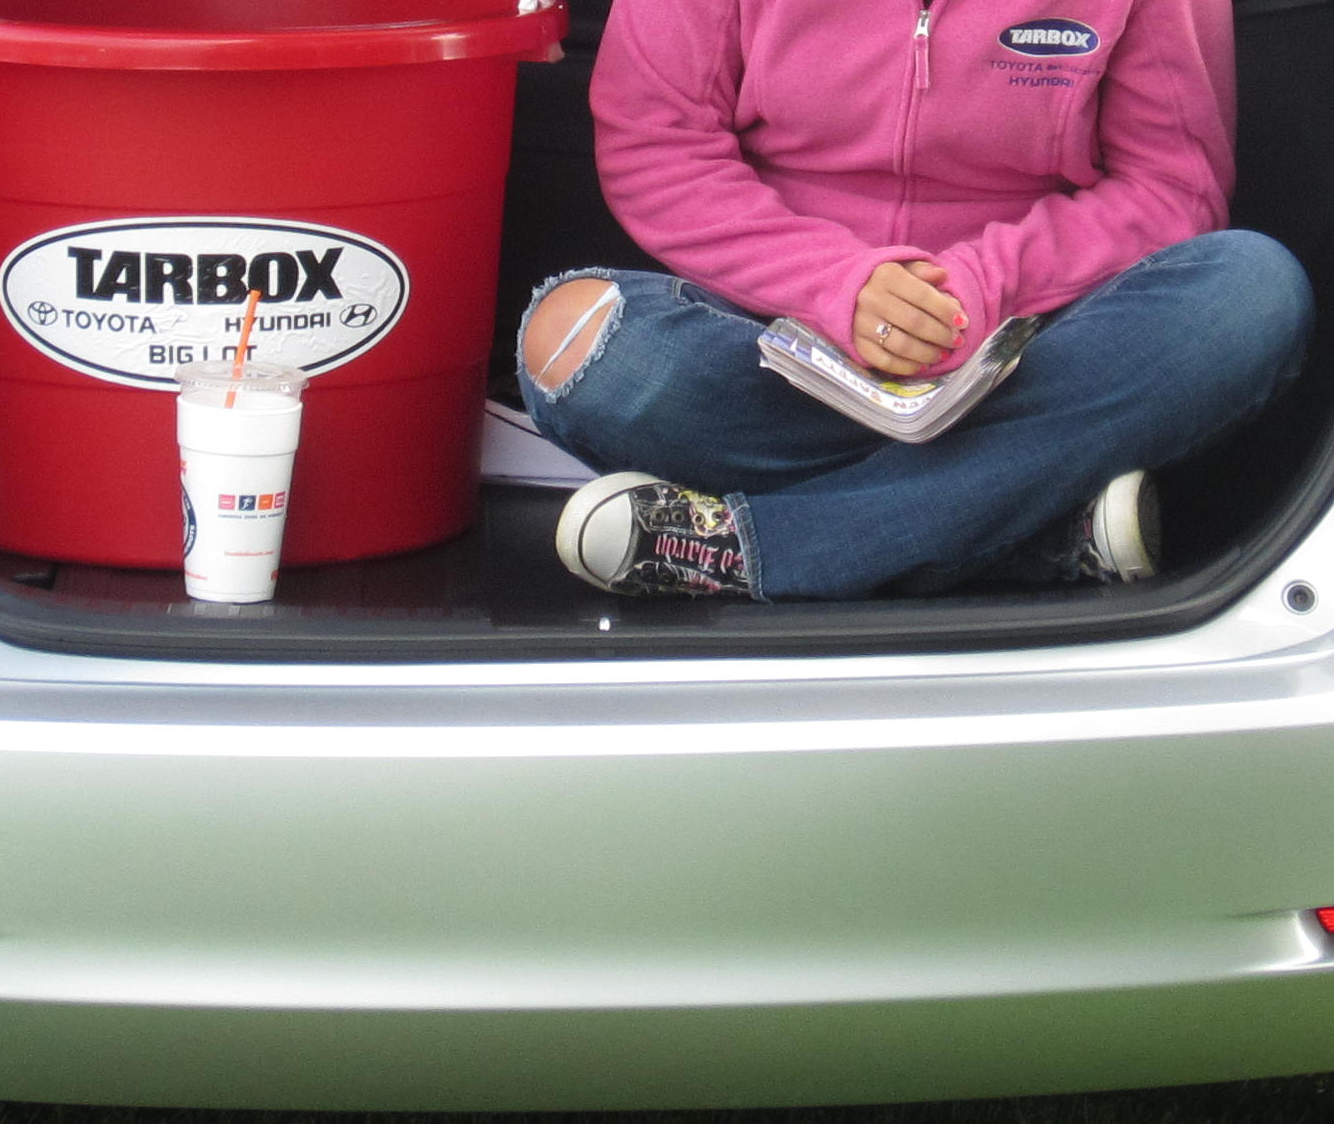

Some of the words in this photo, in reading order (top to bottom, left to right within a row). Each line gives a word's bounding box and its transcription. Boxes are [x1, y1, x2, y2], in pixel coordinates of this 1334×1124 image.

[1009, 29, 1091, 48] TARBOX
[990, 60, 1043, 72] TOYOTA
[1008, 76, 1074, 88] HYUNDAI
[67, 246, 345, 305] TARBOX
[62, 309, 157, 334] TOYOTA
[224, 312, 332, 333] HYUNDAI
[149, 345, 194, 364] BIG
